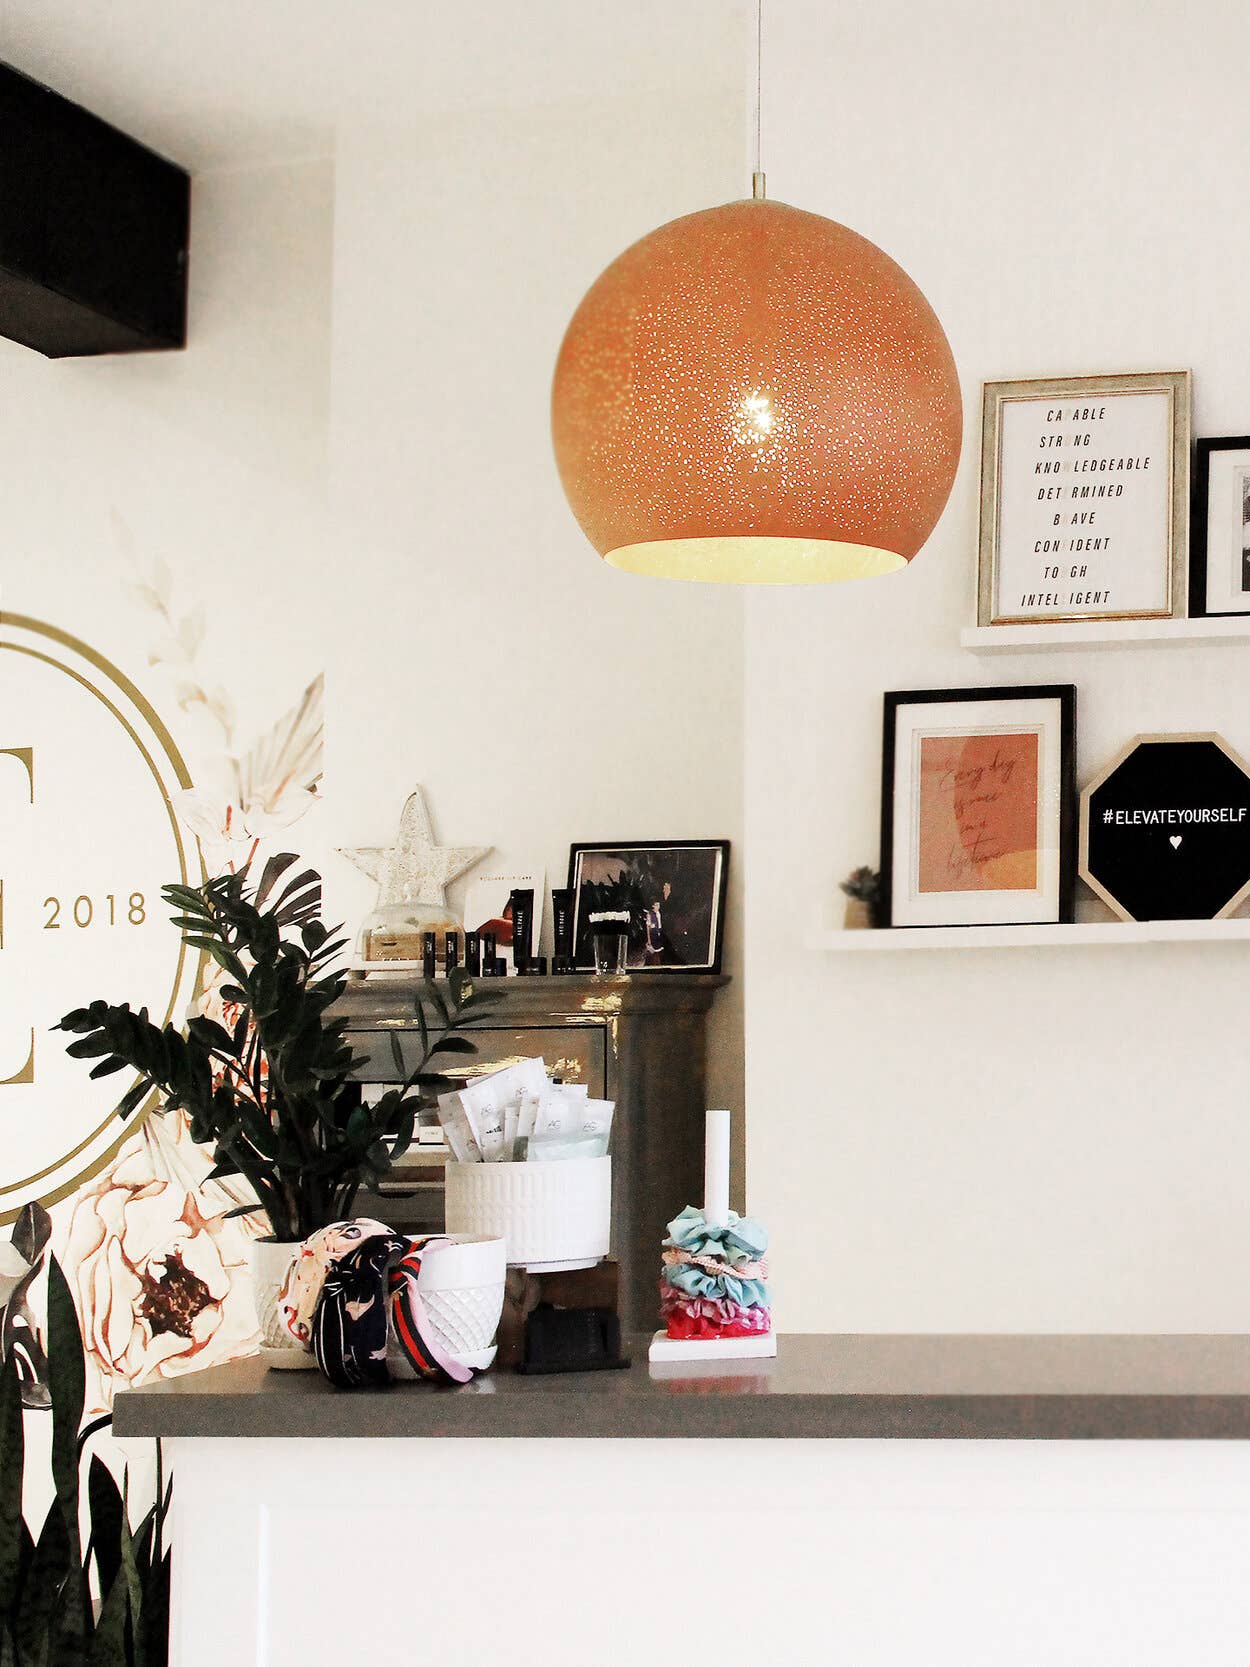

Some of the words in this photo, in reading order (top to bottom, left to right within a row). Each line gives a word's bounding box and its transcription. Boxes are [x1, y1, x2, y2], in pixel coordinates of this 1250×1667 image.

[1038, 484, 1124, 500] DETRMINED
[1053, 512, 1096, 526] BAVE
[1034, 537, 1111, 553] CONIDENT
[1044, 565, 1088, 579] TOGH
[1021, 591, 1111, 607] INTELIGENT
[1102, 808, 1247, 825] #ELEVATEYOURSELF
[43, 892, 146, 929] 2018
